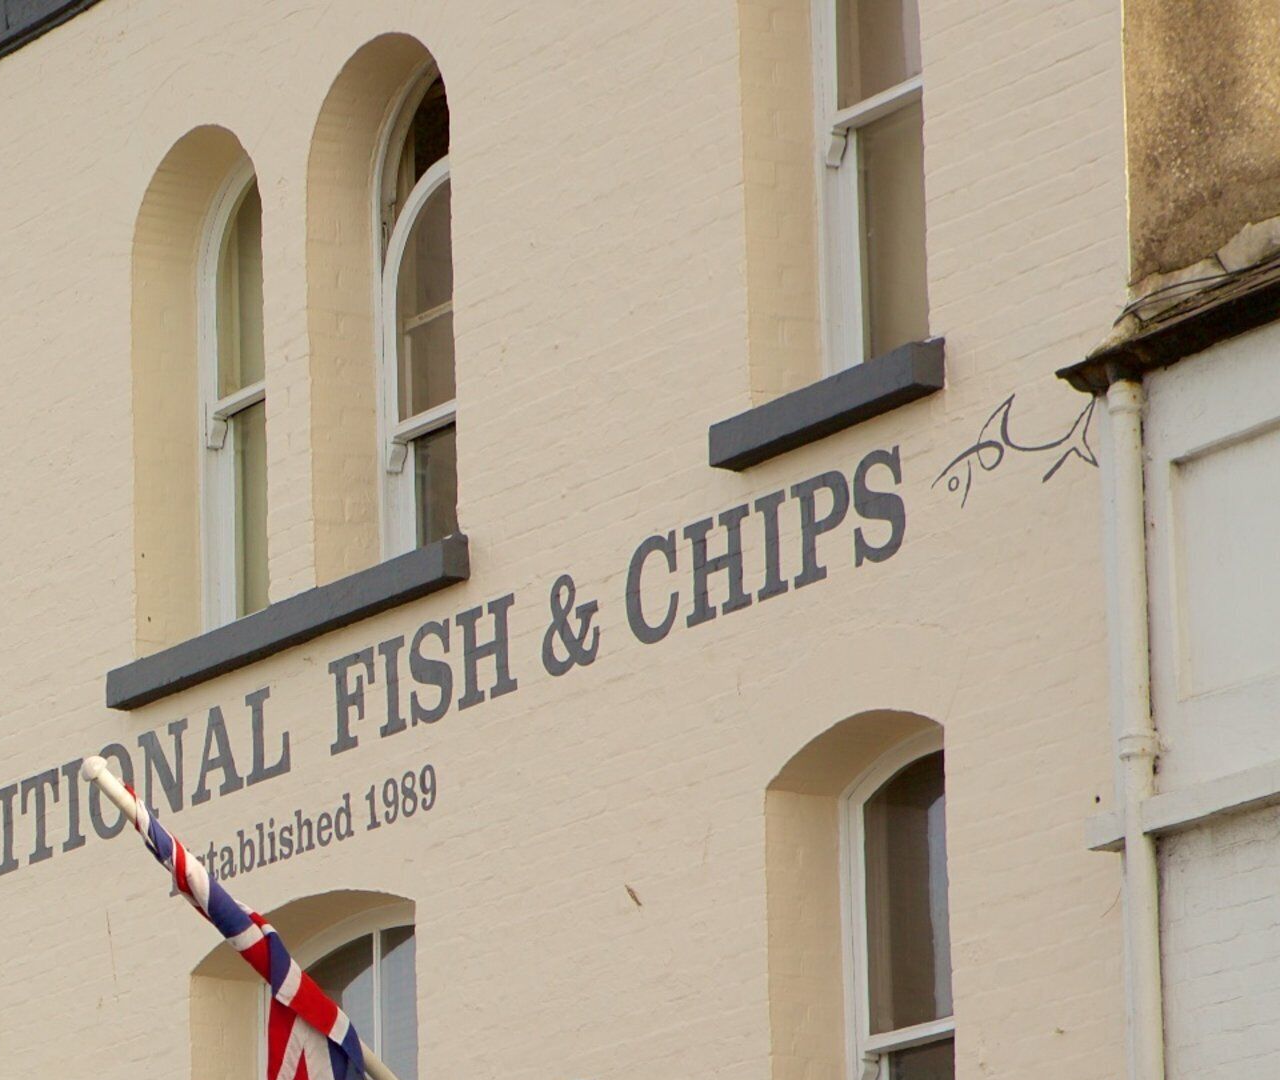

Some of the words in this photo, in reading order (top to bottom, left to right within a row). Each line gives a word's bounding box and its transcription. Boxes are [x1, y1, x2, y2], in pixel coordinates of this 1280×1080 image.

[328, 592, 518, 756] FISH
[541, 573, 601, 677] &
[624, 444, 907, 645] CHIPS
[169, 792, 355, 898] tablished
[365, 763, 437, 832] 1989
